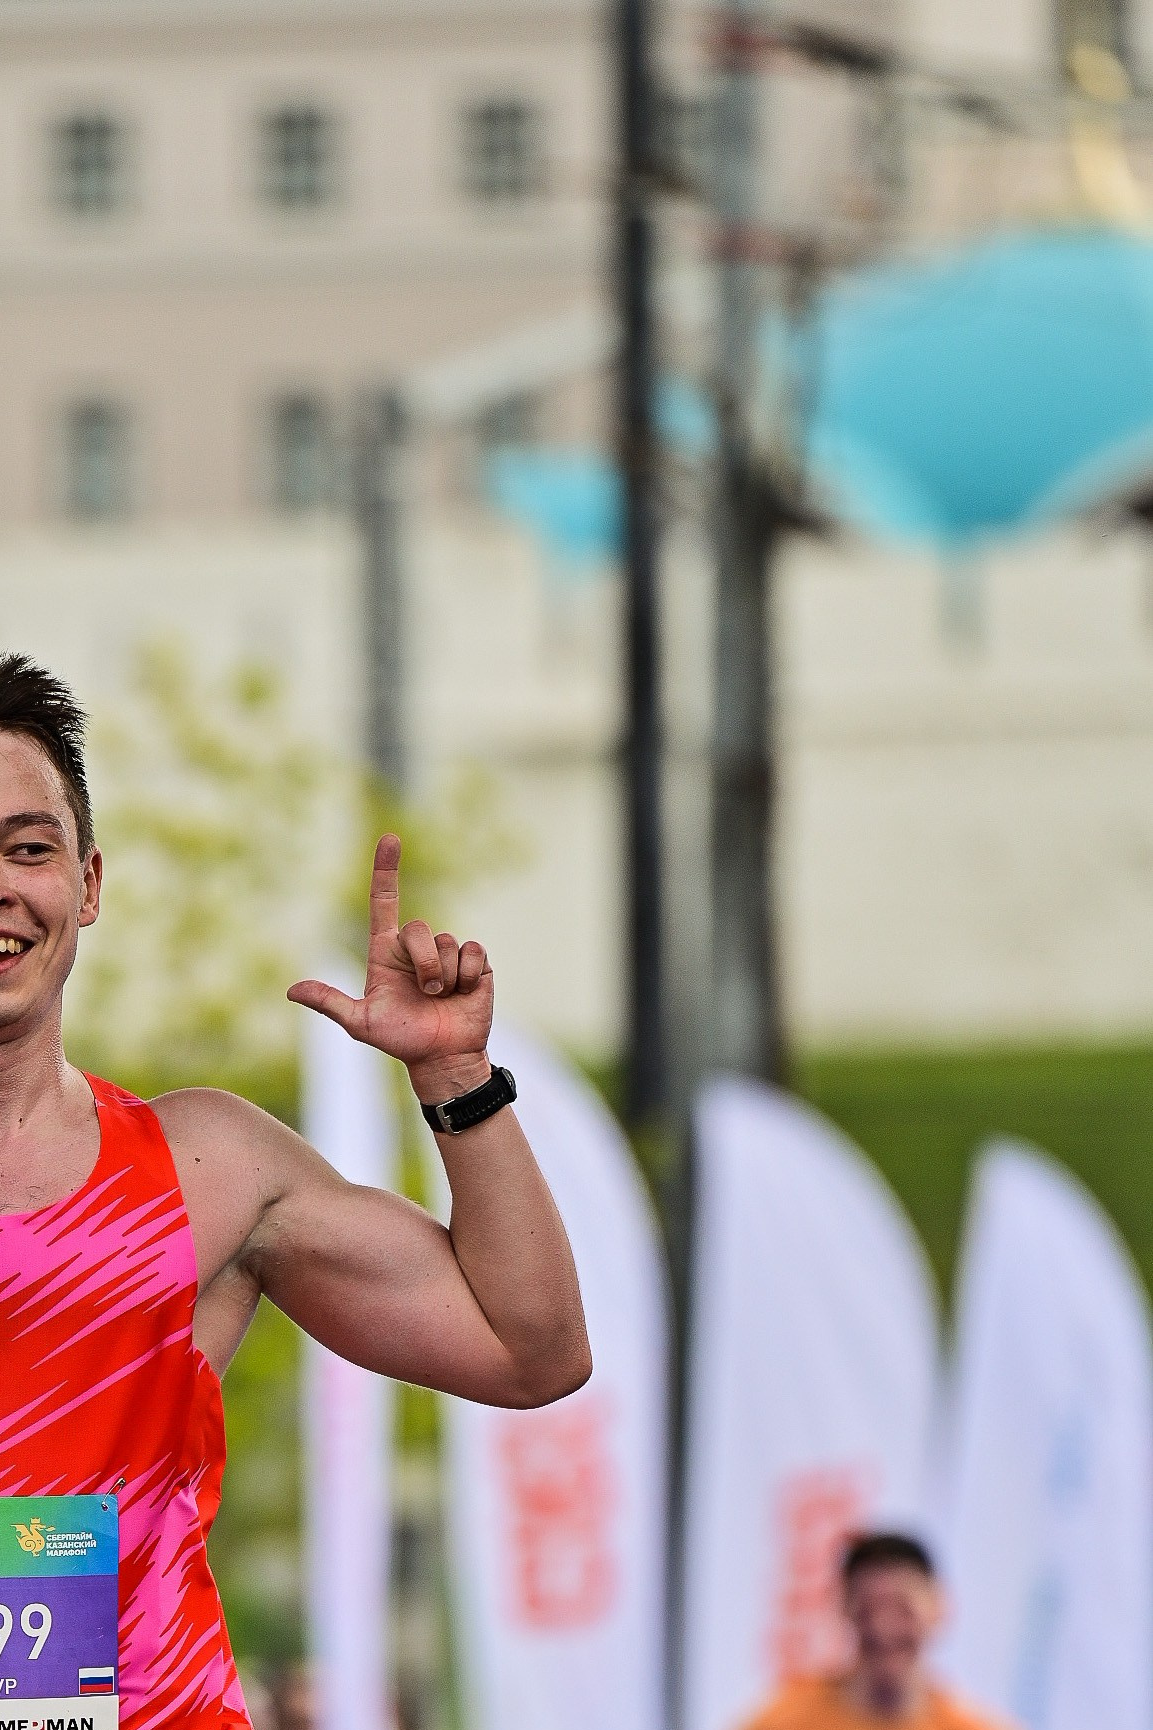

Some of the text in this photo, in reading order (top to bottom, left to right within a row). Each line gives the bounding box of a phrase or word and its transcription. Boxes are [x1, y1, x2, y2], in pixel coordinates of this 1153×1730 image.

[46, 1531, 93, 1541] СБЕРПРАЙМ
[46, 1539, 97, 1549] КАЗАНСКИЙ
[46, 1548, 87, 1557] МАРАФОН
